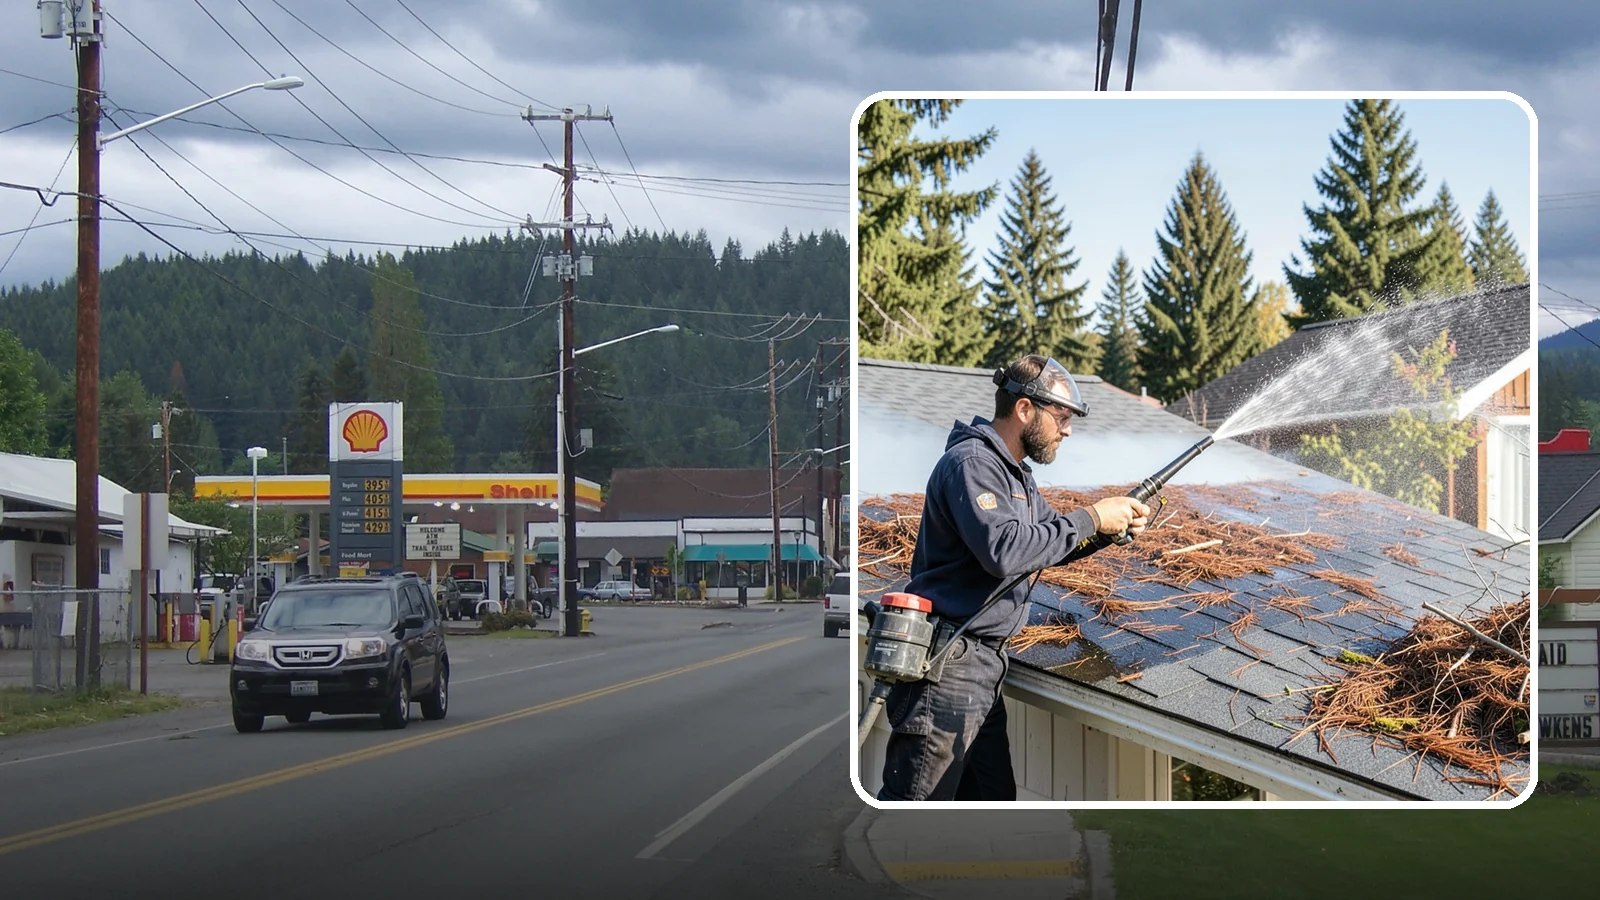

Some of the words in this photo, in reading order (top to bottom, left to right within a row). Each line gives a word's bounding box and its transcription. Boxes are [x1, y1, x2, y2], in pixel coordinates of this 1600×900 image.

[490, 484, 547, 499] Shell
[1538, 643, 1566, 665] AID
[1538, 716, 1592, 738] WKENS
